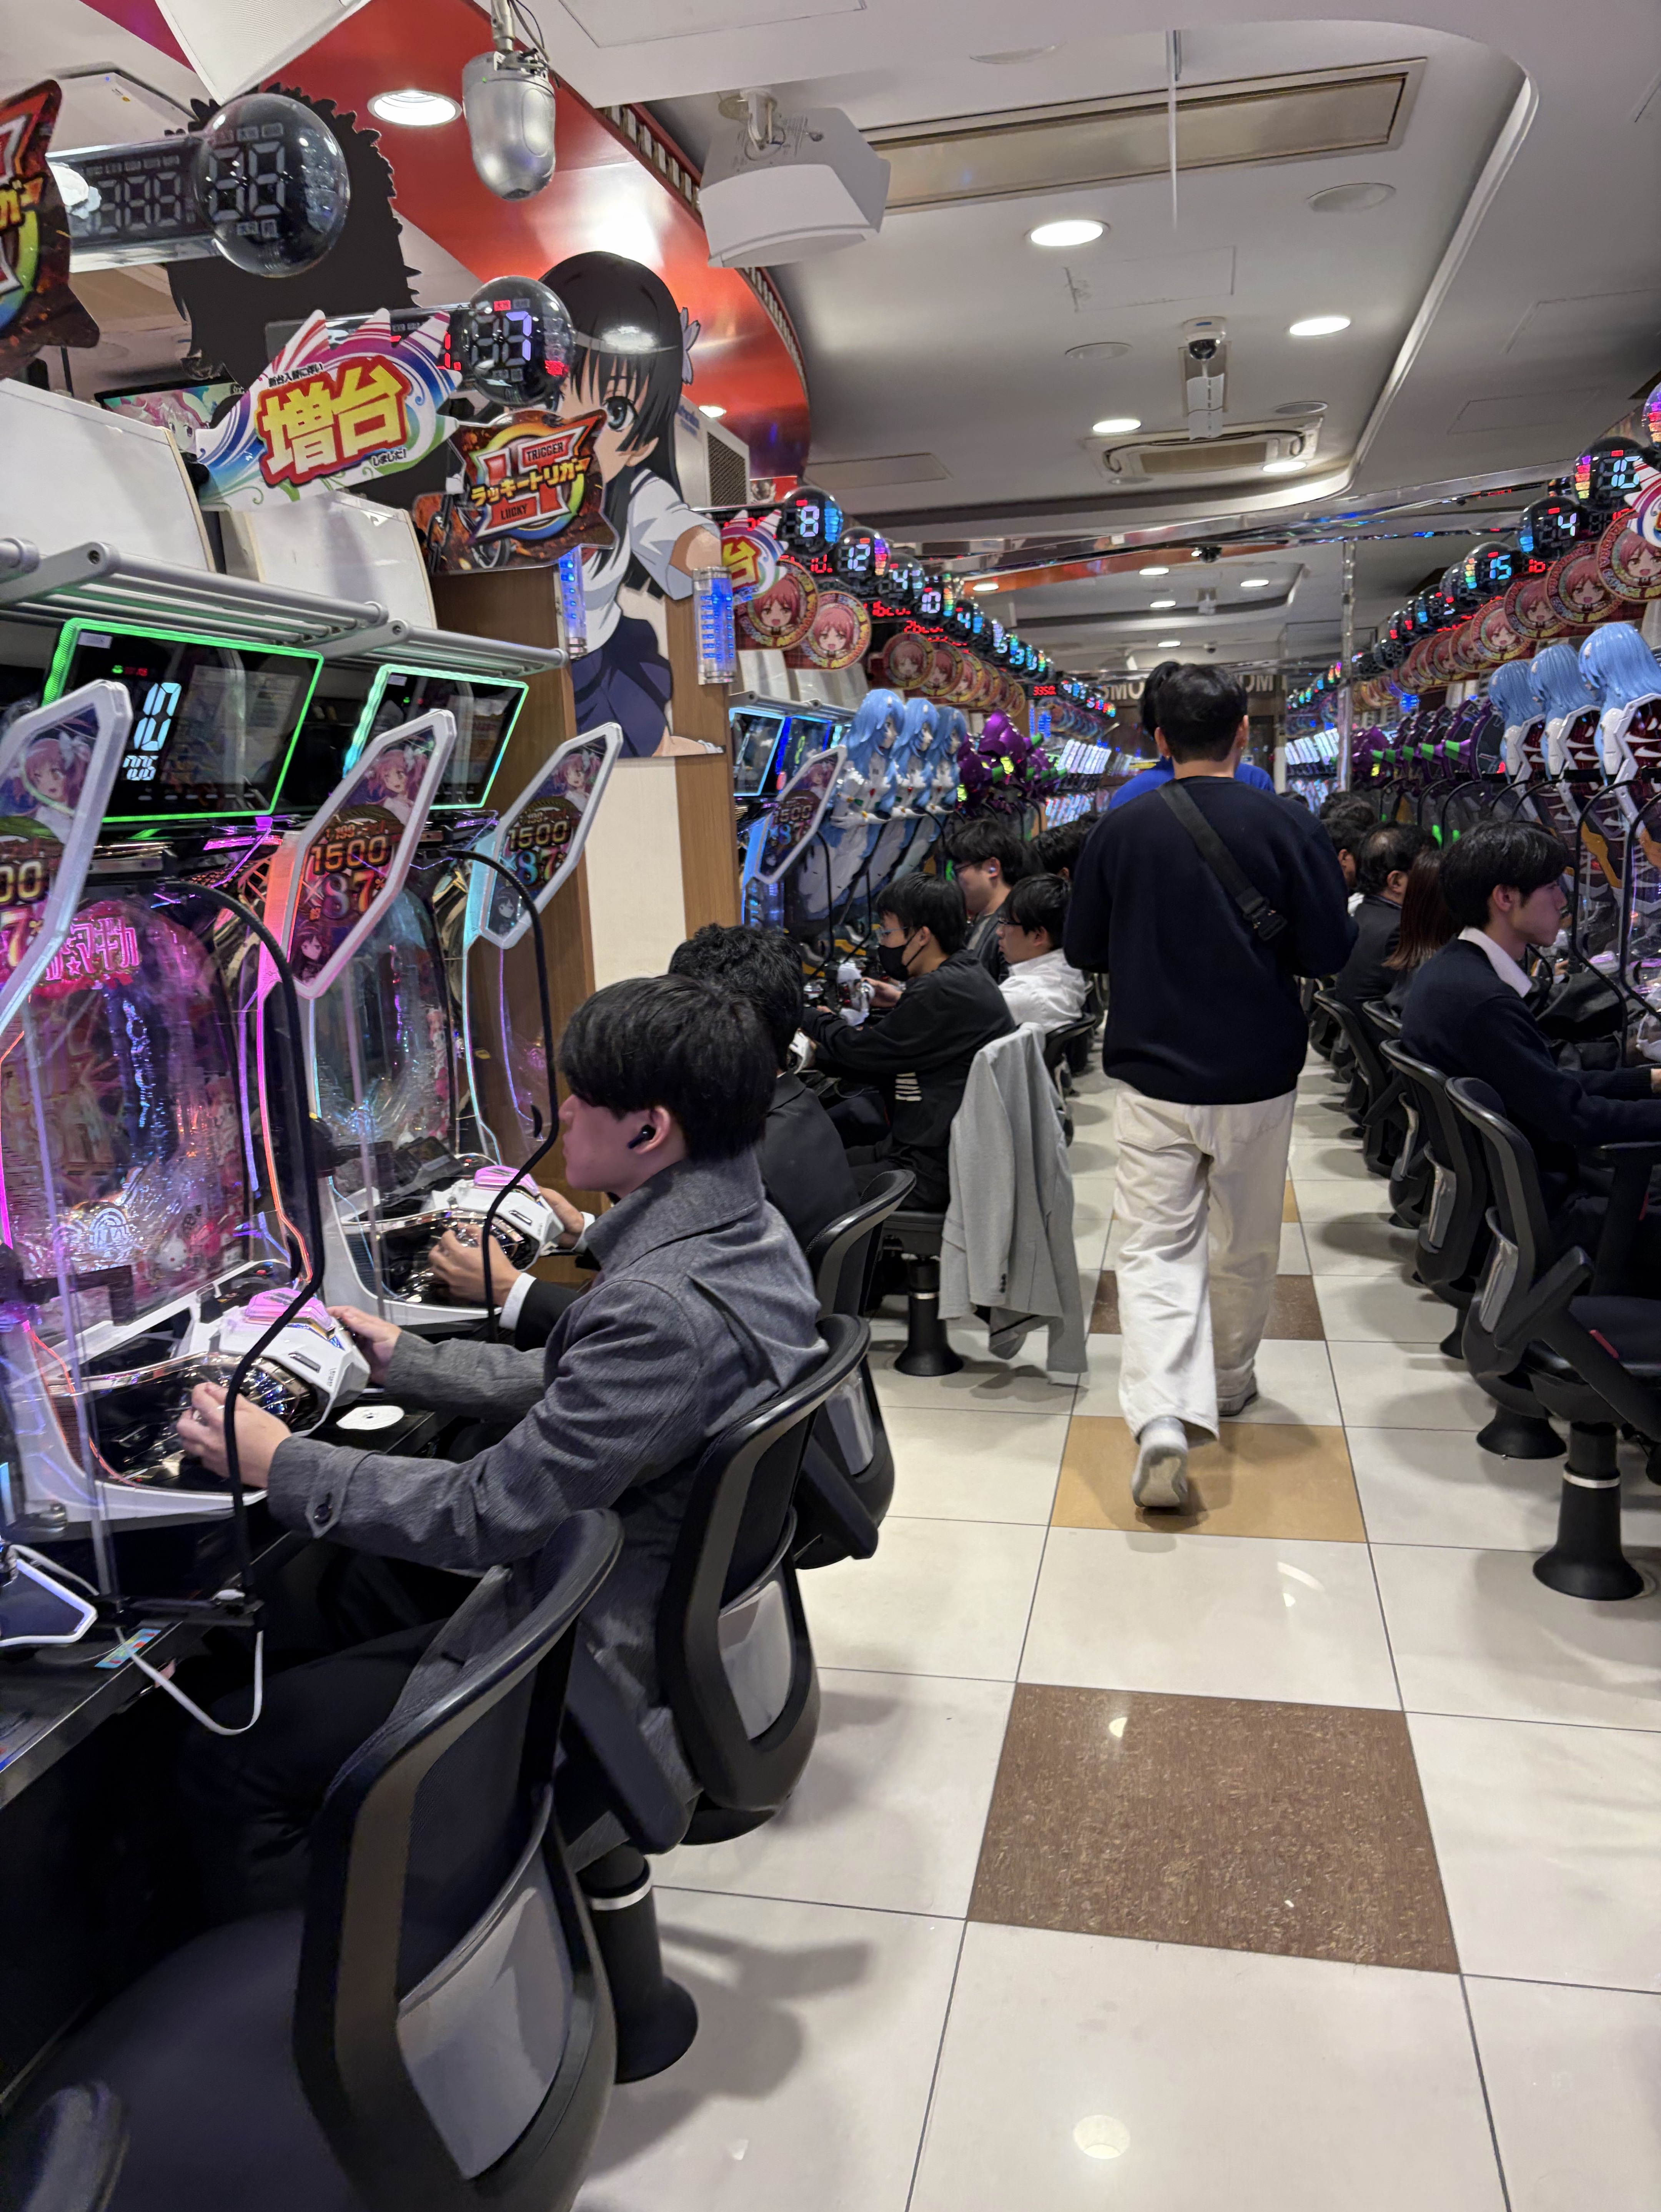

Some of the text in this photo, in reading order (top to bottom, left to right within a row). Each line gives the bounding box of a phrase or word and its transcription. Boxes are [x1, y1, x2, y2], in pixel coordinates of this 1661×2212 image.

[262, 364, 403, 474] 増台
[526, 442, 564, 462] TRIGGER
[471, 457, 591, 507] ラッキートリガー
[500, 504, 528, 520] LUCKY
[800, 506, 820, 537] 8
[1558, 513, 1576, 536] 4
[848, 544, 870, 571] 12
[1490, 555, 1511, 580] 15
[892, 570, 908, 590] 4
[922, 592, 941, 614] 10
[508, 821, 568, 850] 1500
[311, 835, 388, 872] 1500
[322, 870, 375, 919] 87
